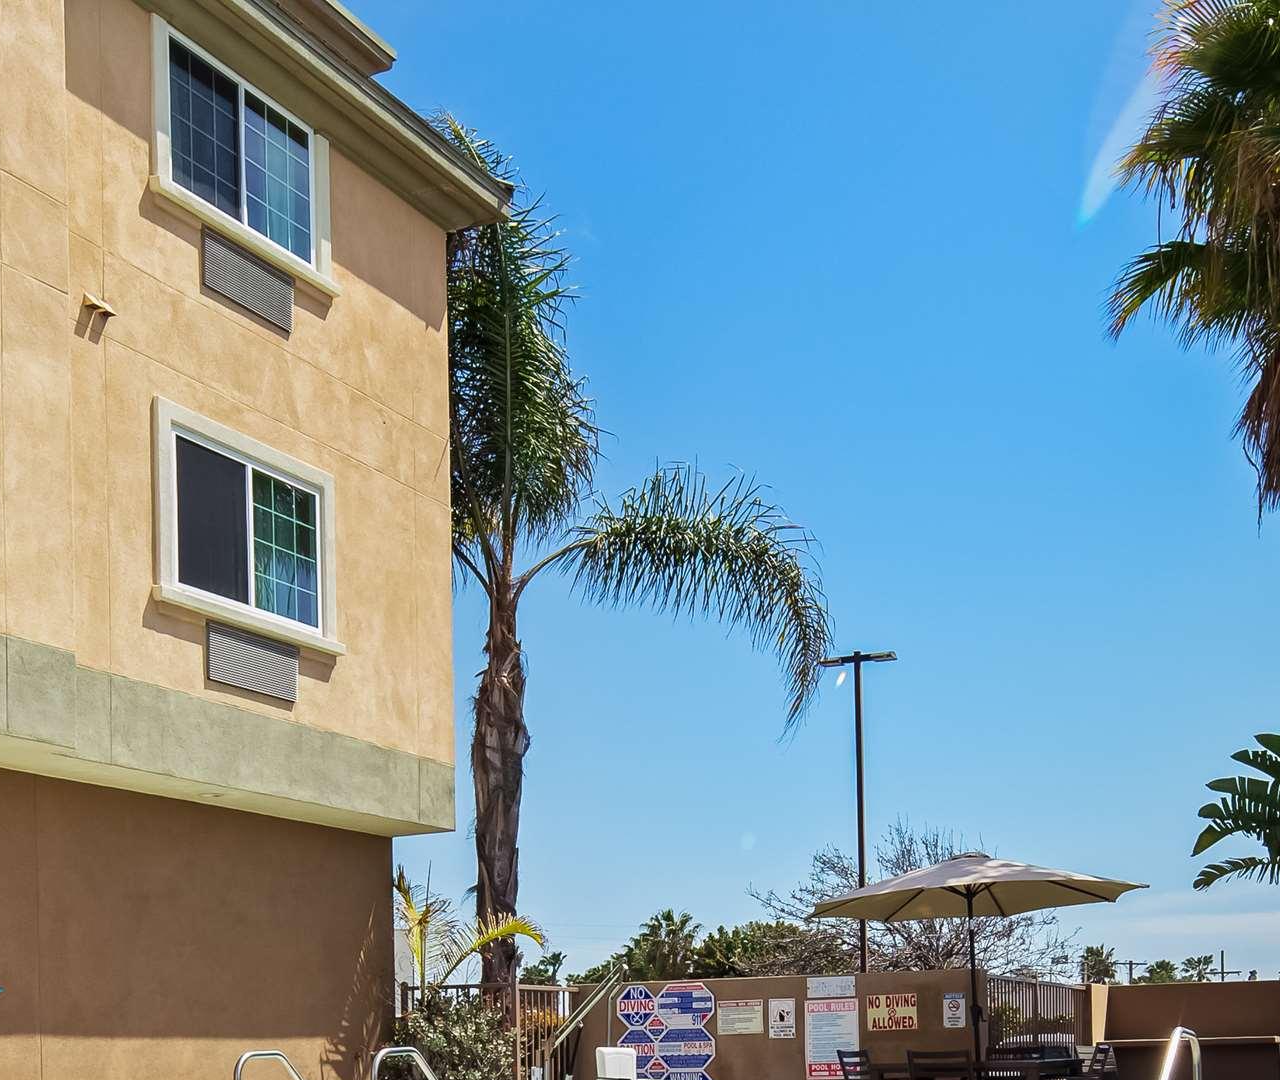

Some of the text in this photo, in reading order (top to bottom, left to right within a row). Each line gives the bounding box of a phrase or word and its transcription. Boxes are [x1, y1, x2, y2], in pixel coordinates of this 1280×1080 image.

[630, 988, 645, 1000] NO
[619, 1000, 655, 1012] DIVING
[808, 1001, 855, 1012] POOL RULES
[868, 994, 916, 1009] NO DIVING
[871, 1015, 914, 1030] ALLOWED
